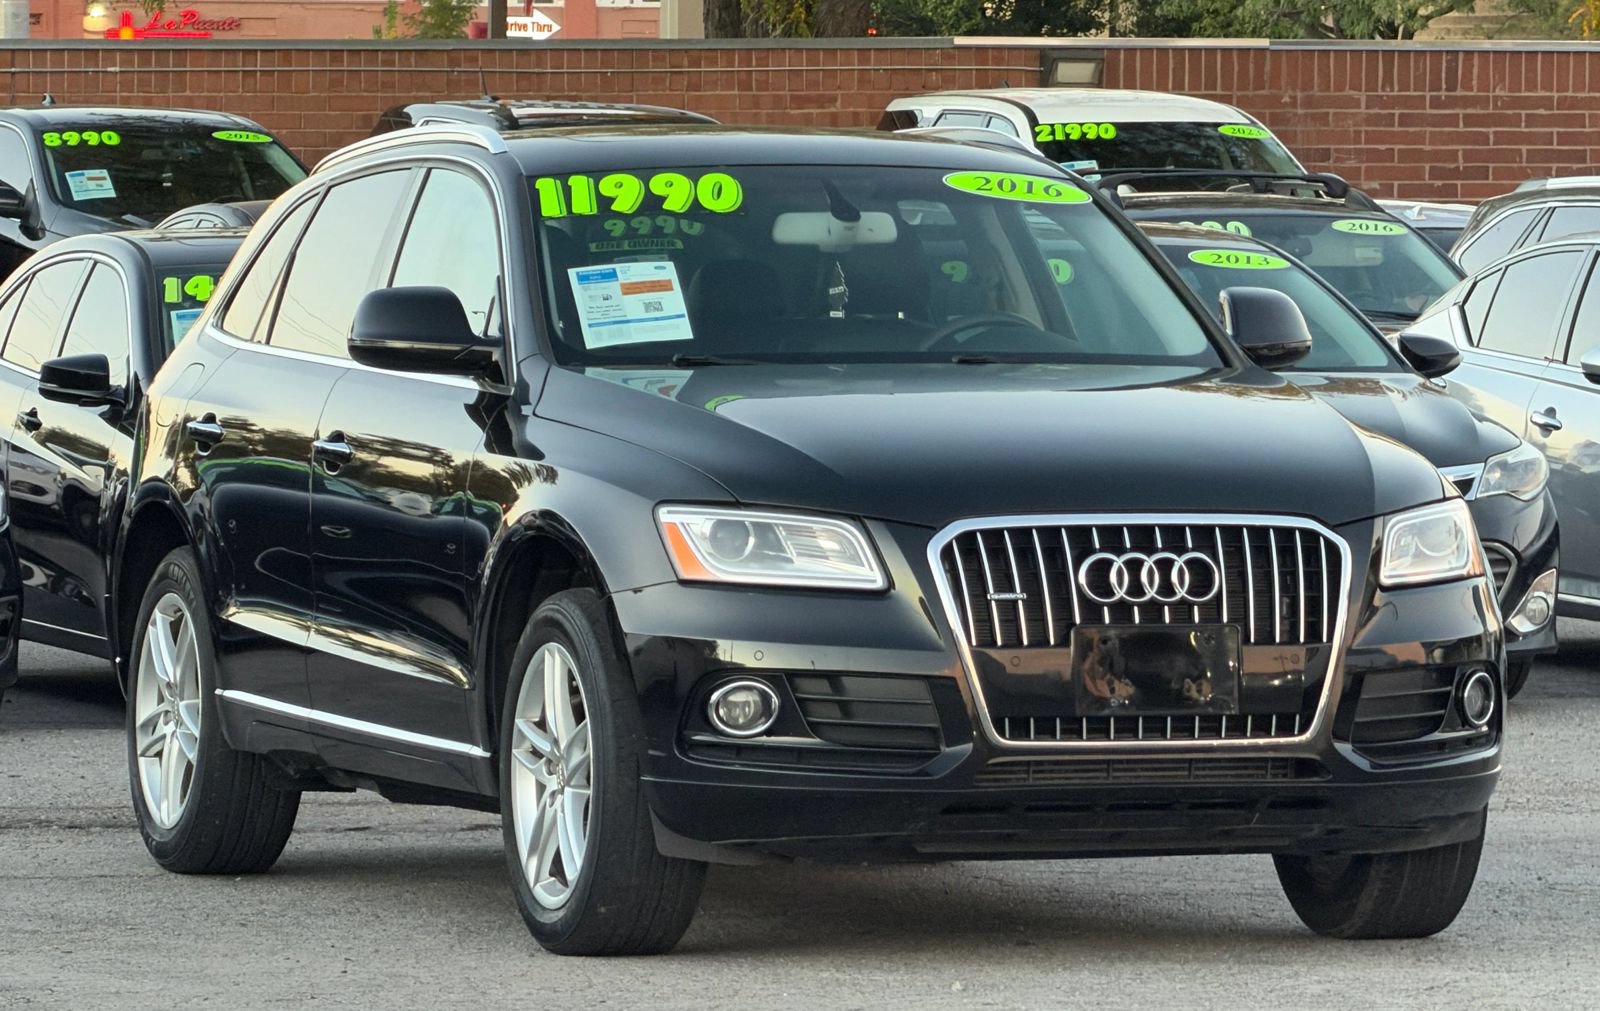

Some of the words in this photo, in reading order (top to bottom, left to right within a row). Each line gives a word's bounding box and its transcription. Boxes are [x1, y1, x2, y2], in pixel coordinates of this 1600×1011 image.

[146, 10, 177, 29] La
[178, 9, 241, 31] Puente
[504, 21, 529, 33] rive
[531, 22, 553, 33] Thru
[42, 130, 121, 147] 8990
[1034, 122, 1117, 142] 21990
[535, 172, 743, 218] 11990
[973, 176, 1063, 198] 2016
[1346, 222, 1394, 233] 2016
[1209, 253, 1271, 266] 2013
